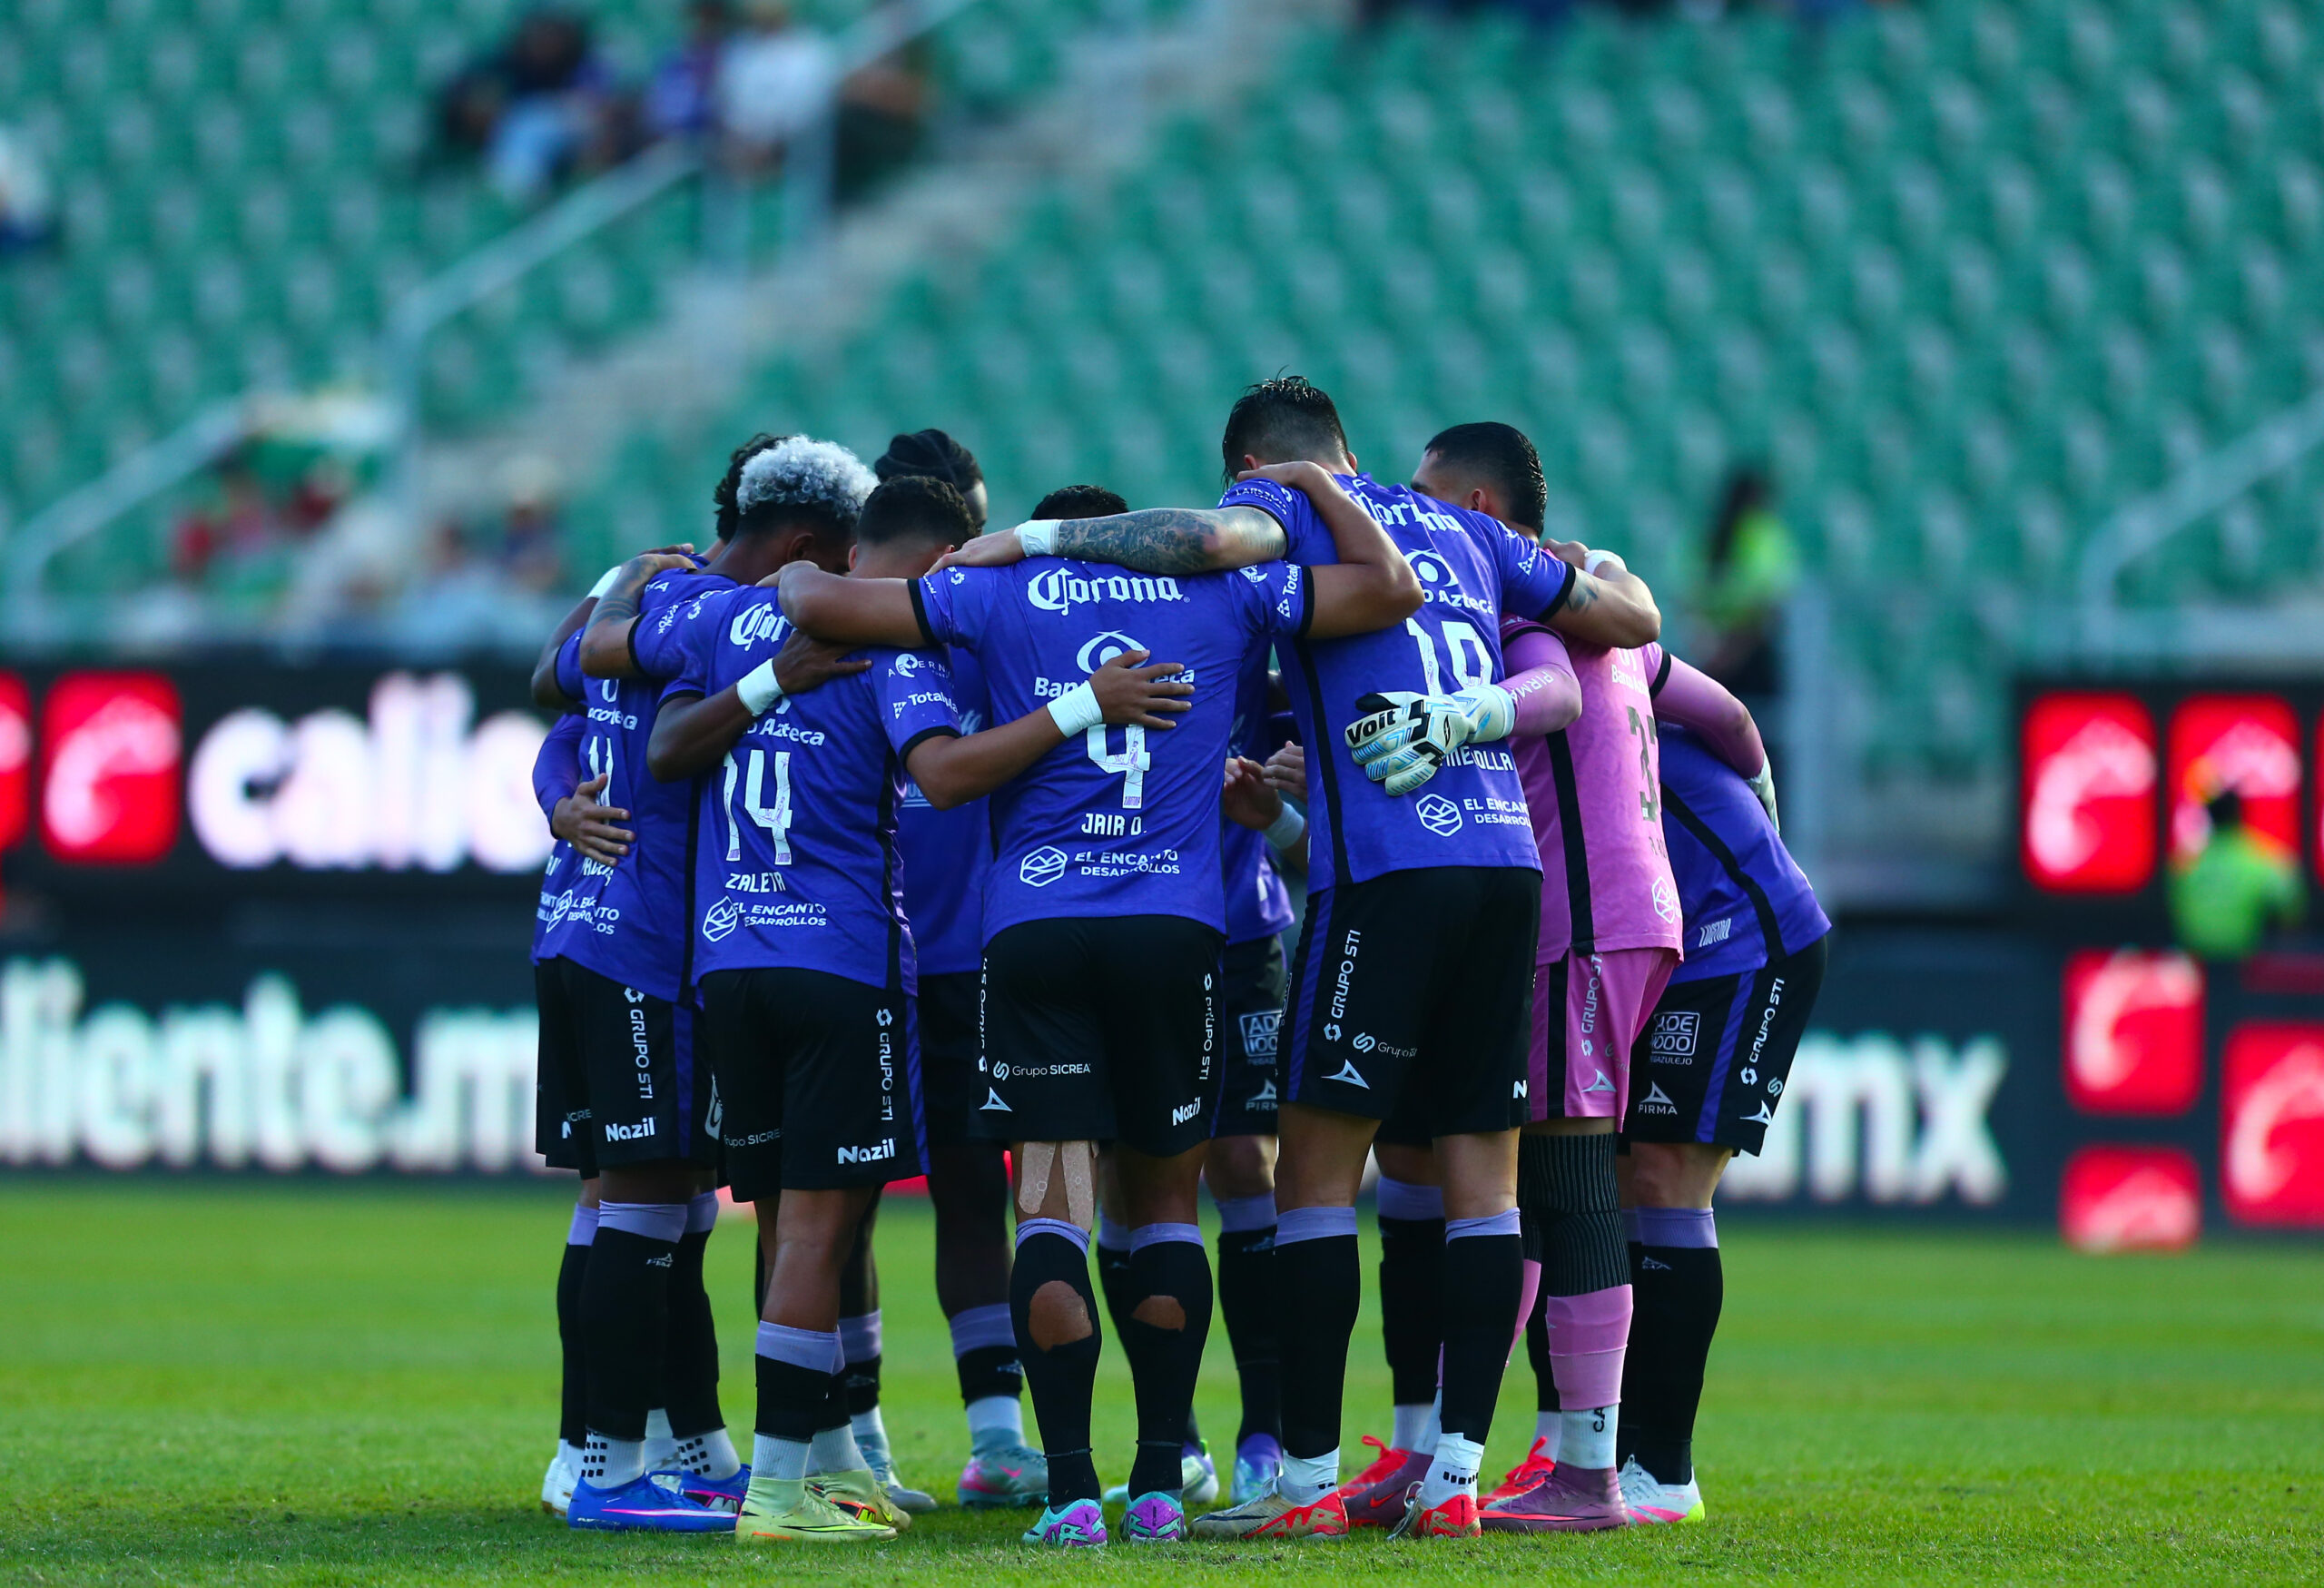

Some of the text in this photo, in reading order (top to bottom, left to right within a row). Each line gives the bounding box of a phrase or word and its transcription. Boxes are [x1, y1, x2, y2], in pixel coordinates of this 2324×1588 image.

[1028, 567, 1184, 616] Corona
[1346, 710, 1396, 746] Voit
[724, 749, 793, 865] 14
[1462, 798, 1529, 818] EL ENCAN
[1081, 814, 1126, 836] JAIR
[1074, 851, 1096, 863] EL
[1331, 929, 1362, 1020] GRUPO STI
[1581, 976, 1600, 1034] GRUPO
[1748, 977, 1786, 1063] GRUPO STI
[630, 1009, 653, 1100] GRUPO STI
[1198, 1055, 1211, 1080] STI
[879, 1032, 894, 1121] GRUPO STI
[1011, 1063, 1090, 1078] Grupo SICREA
[1172, 1097, 1201, 1127] Nazil
[1245, 1100, 1278, 1112] PIRM
[1638, 1103, 1679, 1116] PIRMA
[606, 1117, 655, 1142] Nazil
[837, 1138, 896, 1165] Nazil
